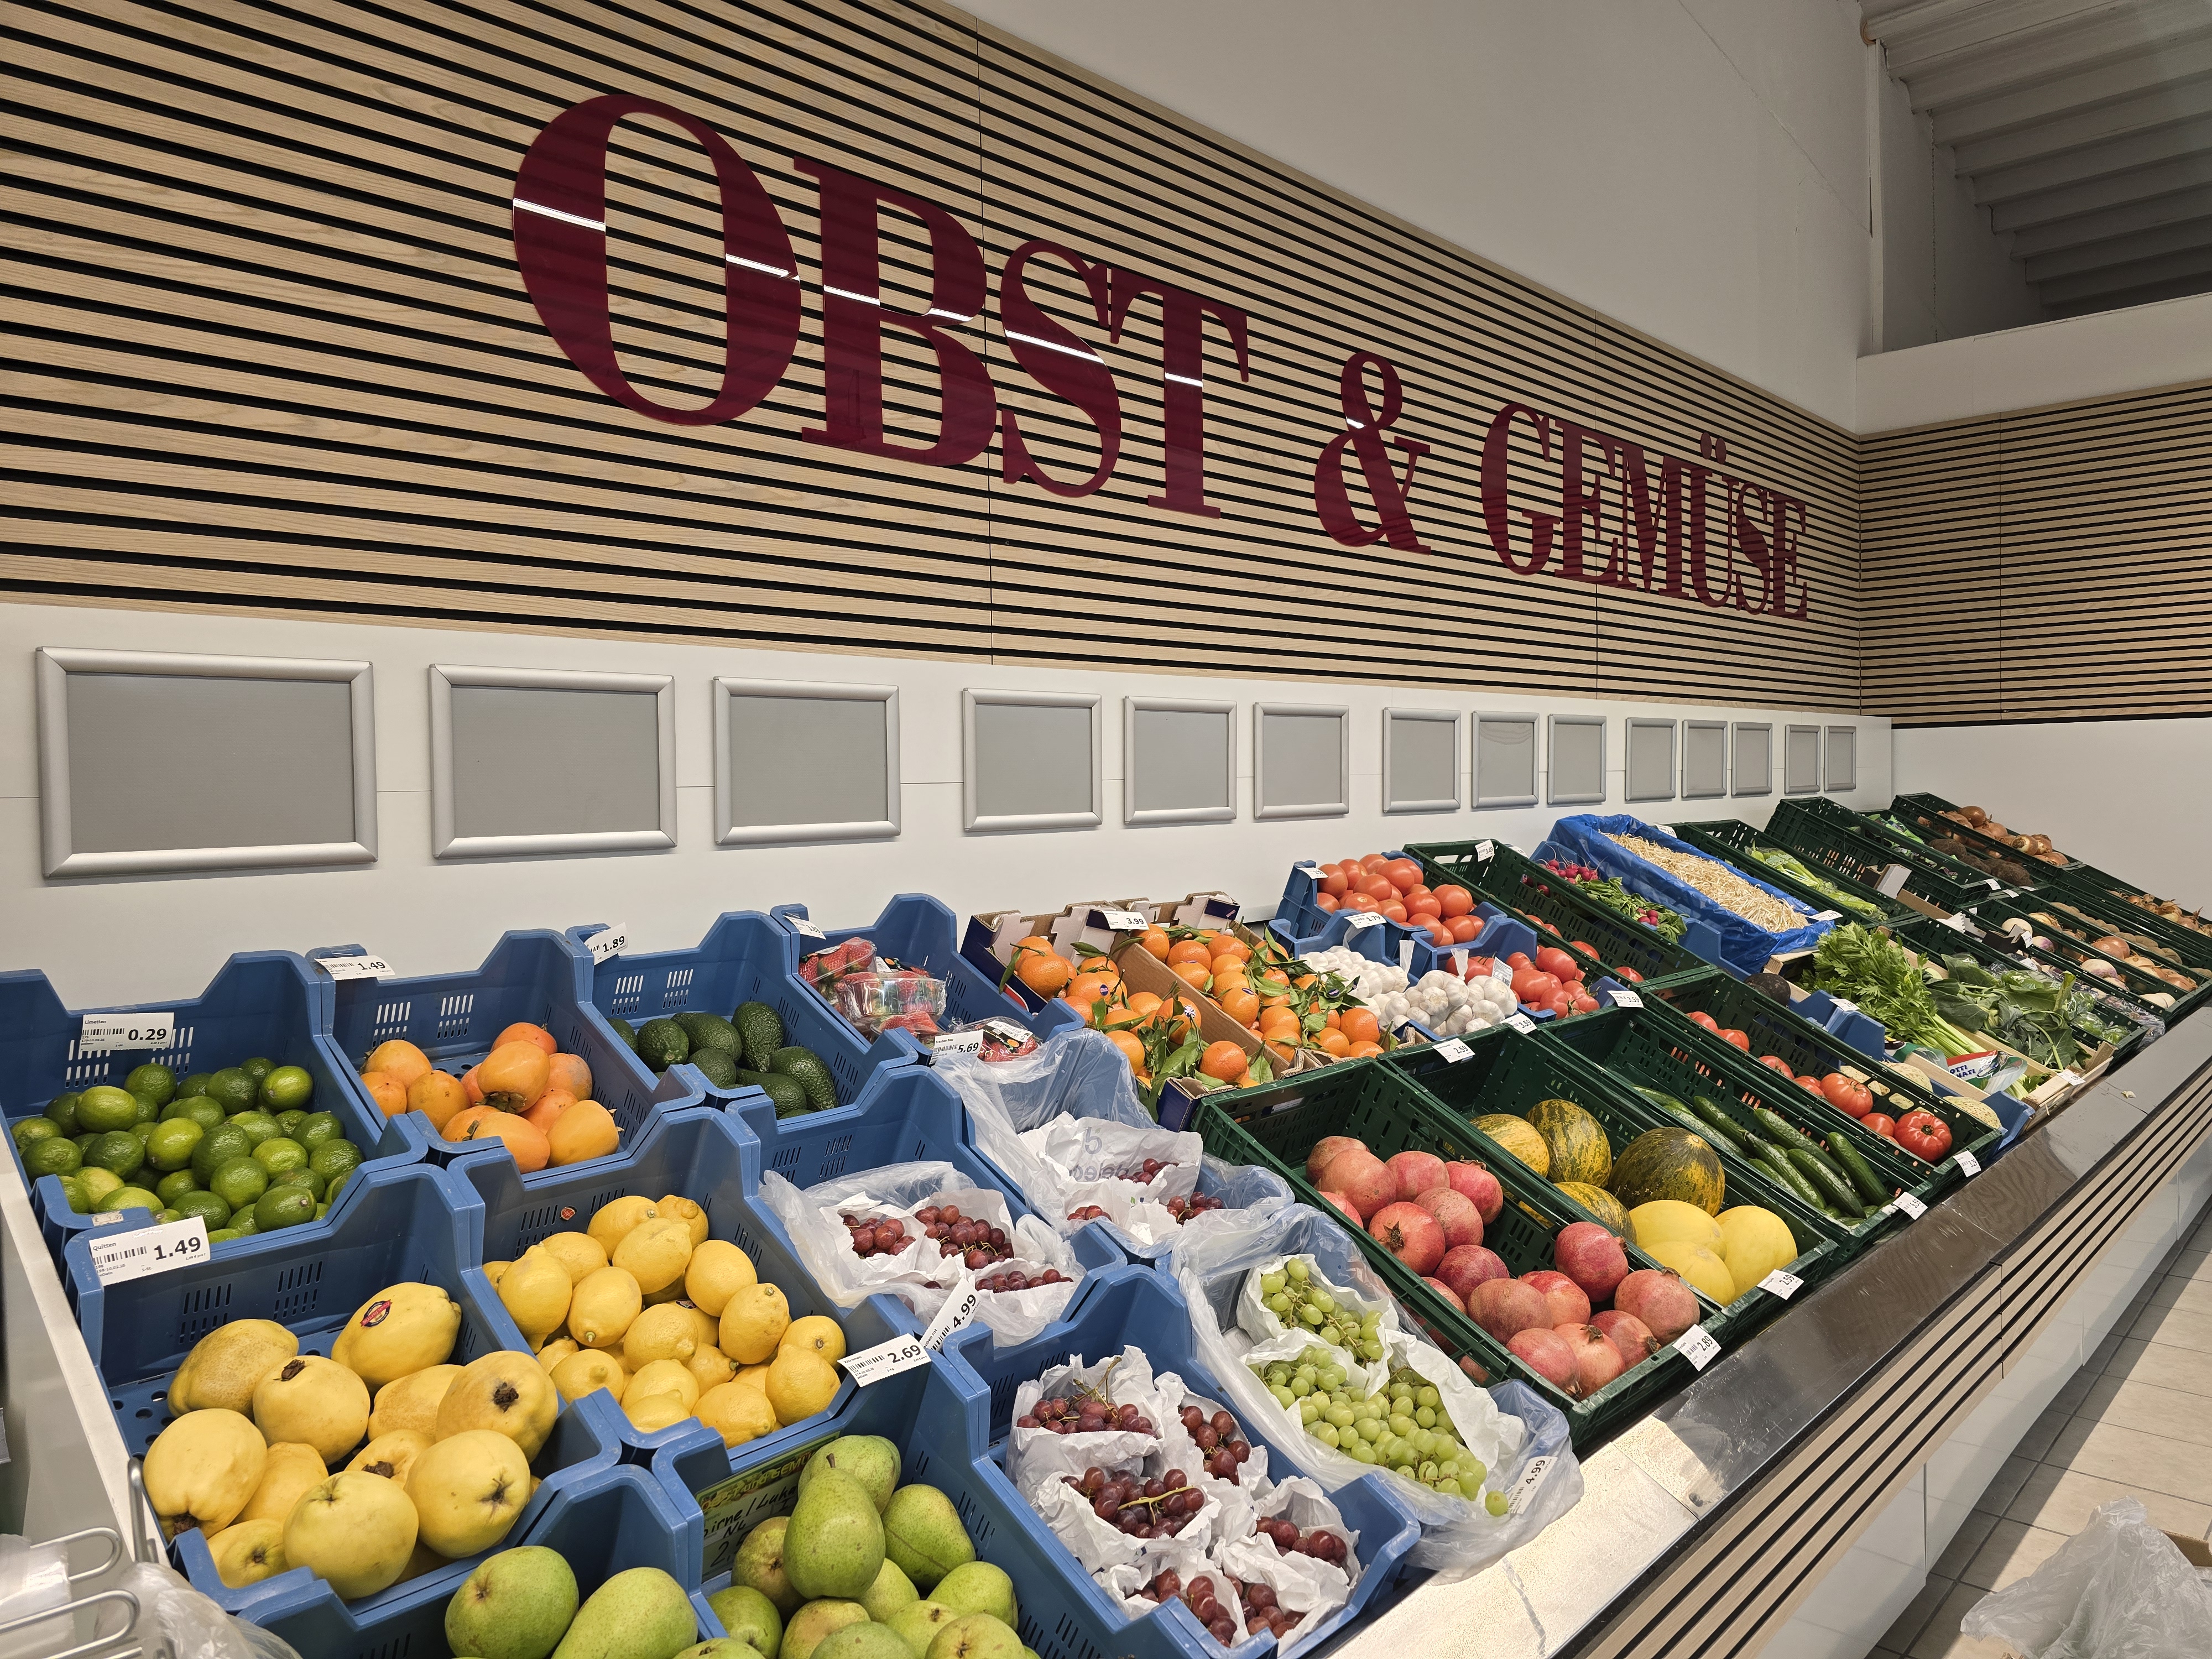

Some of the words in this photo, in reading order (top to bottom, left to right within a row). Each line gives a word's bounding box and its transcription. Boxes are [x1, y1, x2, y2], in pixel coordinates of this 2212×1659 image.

[512, 93, 1249, 519] OBST
[1314, 351, 1431, 555] &
[1481, 402, 1807, 622] GEMÜSE
[602, 936, 625, 953] 1.89
[357, 962, 386, 971] 1.49
[128, 1028, 167, 1041] 0.29
[957, 1042, 979, 1053] 5.69
[1453, 1045, 1468, 1054] 2.59
[1950, 1065, 1968, 1074] OTTI
[92, 1242, 117, 1251] Quitten
[154, 1237, 201, 1261] 1.49
[1779, 1275, 1795, 1286] 2.59
[953, 1294, 976, 1328] 4.99
[923, 1335, 933, 1349] auben
[1697, 1335, 1713, 1352] 2.89
[887, 1344, 921, 1364] 2.69
[770, 1451, 816, 1480] GEMÜ
[1525, 1460, 1546, 1484] 4.99
